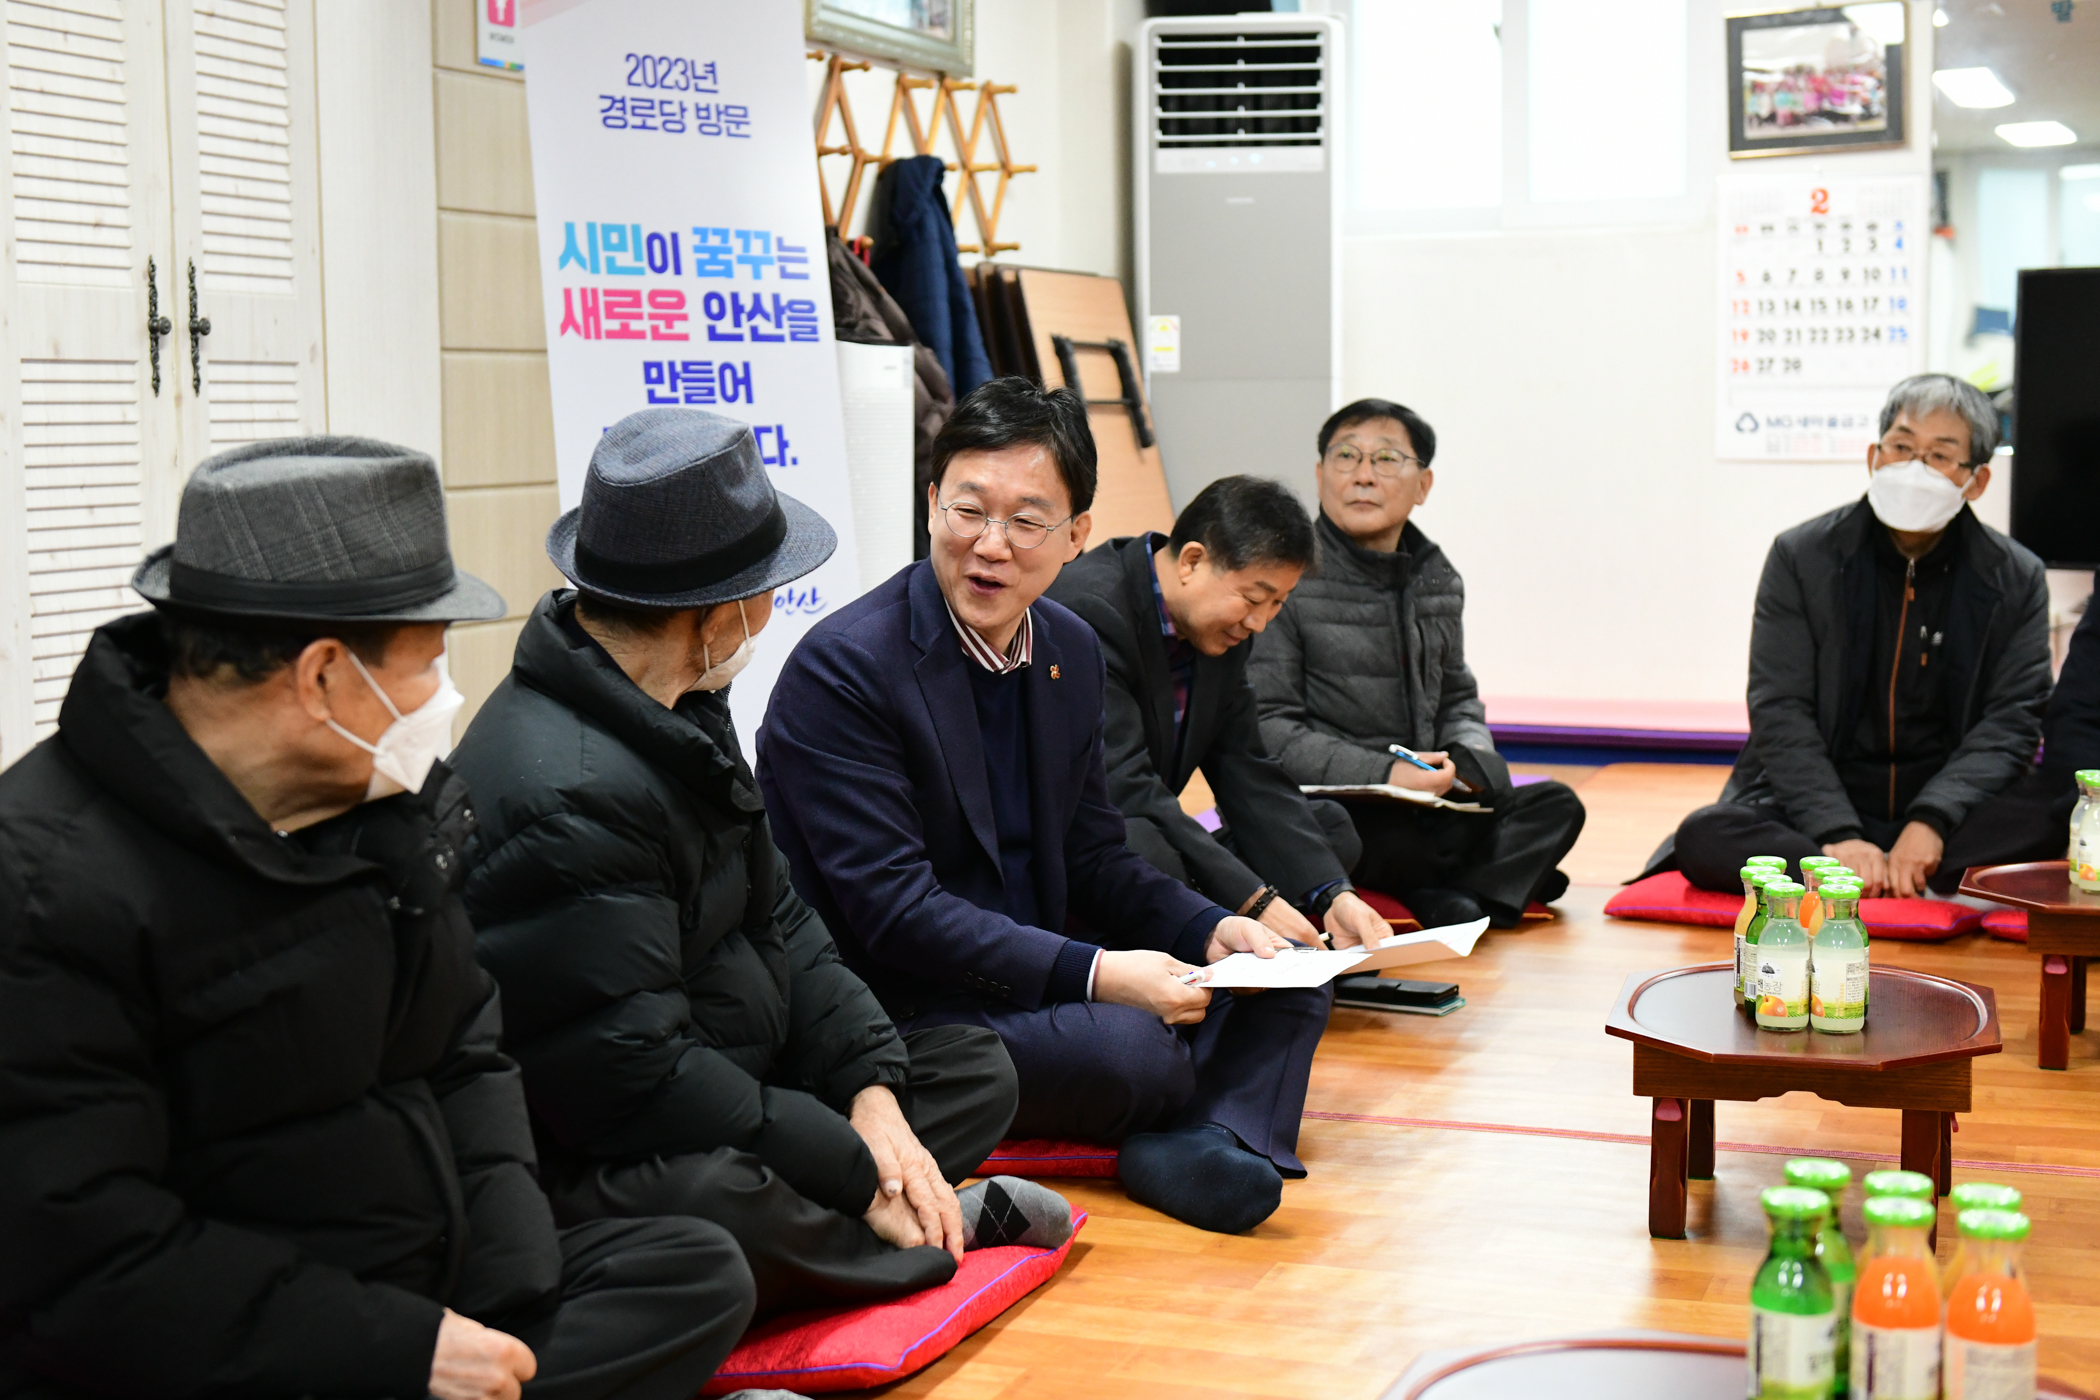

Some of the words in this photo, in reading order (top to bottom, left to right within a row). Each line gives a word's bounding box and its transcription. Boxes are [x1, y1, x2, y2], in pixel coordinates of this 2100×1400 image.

[625, 53, 719, 94] 2023년
[599, 94, 688, 134] 경로당
[695, 102, 752, 139] 방문
[1810, 187, 1830, 216] 2
[558, 221, 682, 276] 시민이
[692, 226, 811, 281] 꿈꾸는
[559, 286, 691, 342] 새로운
[702, 290, 821, 344] 안산을
[642, 359, 755, 405] 만들어
[774, 586, 828, 617] 안산
